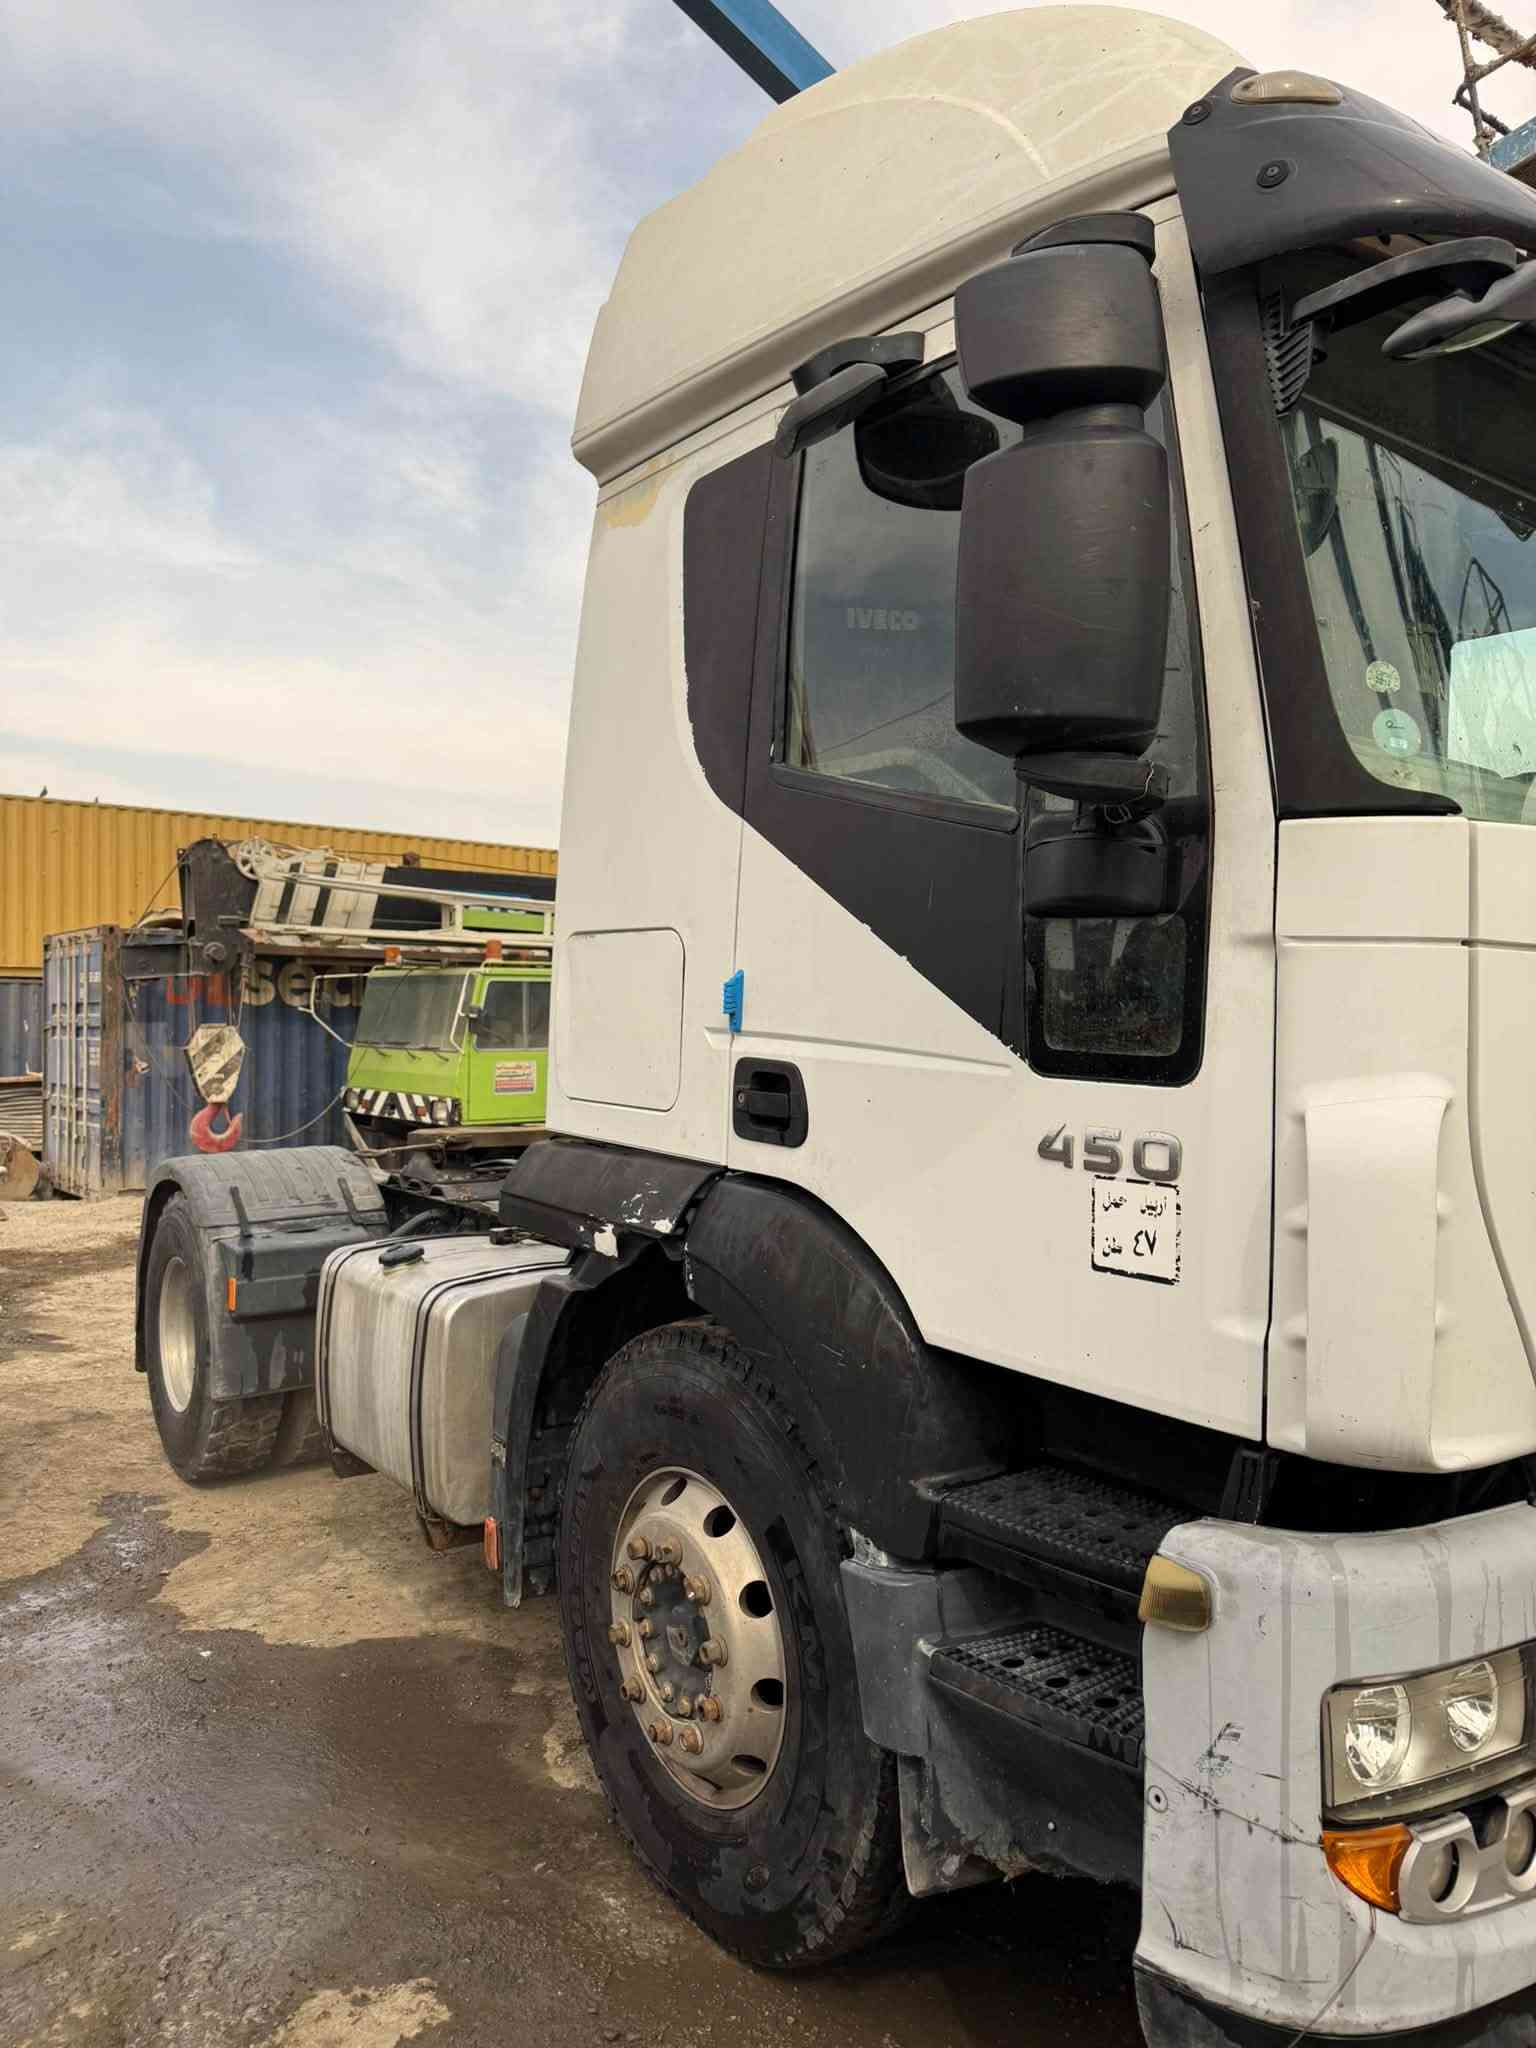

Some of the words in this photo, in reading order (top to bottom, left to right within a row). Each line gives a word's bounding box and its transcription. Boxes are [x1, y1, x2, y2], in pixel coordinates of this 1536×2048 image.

[847, 608, 920, 631] IVECO
[1037, 1123, 1183, 1182] 450
[1133, 1229, 1157, 1257] ٤٧
